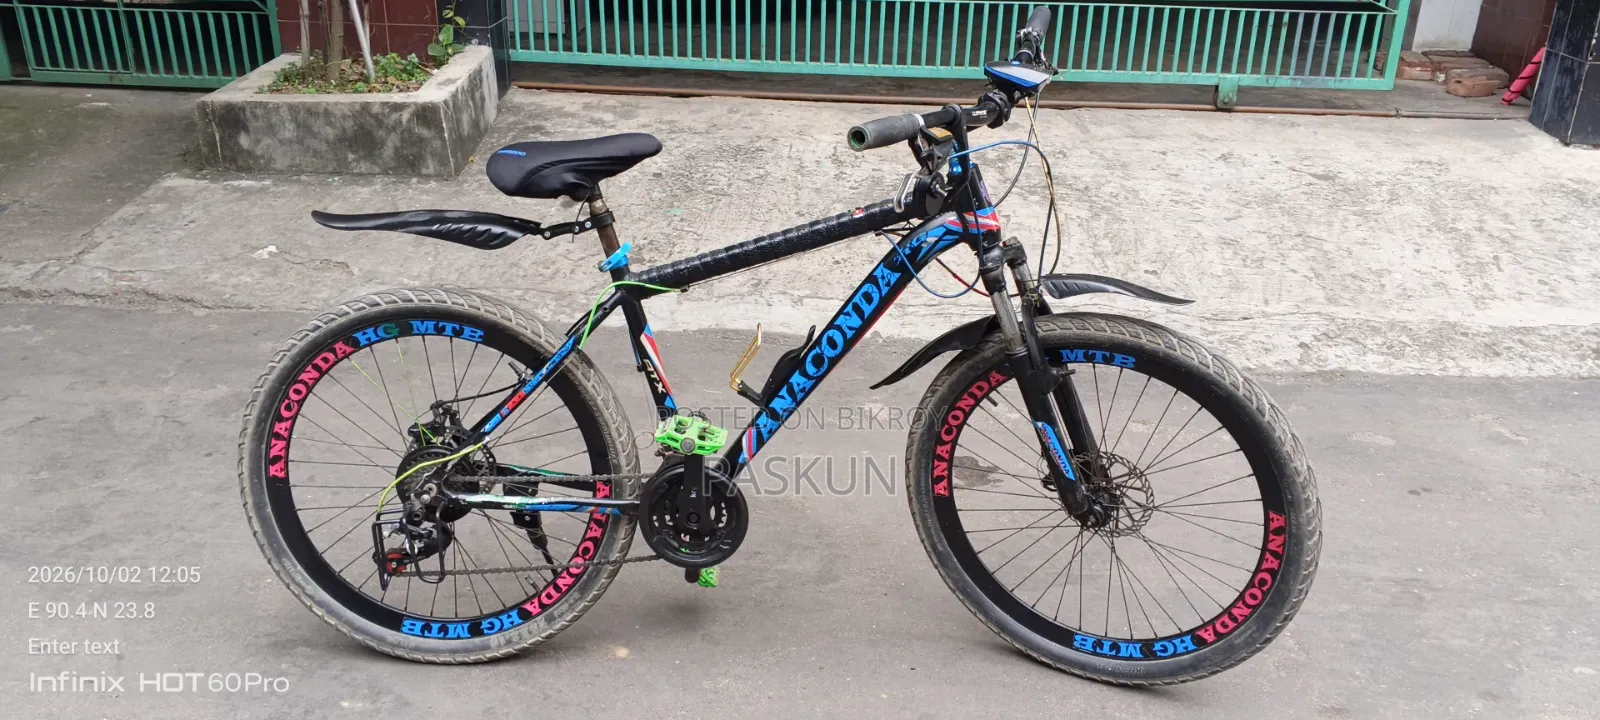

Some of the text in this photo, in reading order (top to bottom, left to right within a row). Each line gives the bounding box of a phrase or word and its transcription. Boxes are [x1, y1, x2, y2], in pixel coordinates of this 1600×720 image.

[268, 319, 484, 479] ANACONDA HG MTB
[753, 261, 902, 442] ANACONDA
[1060, 348, 1137, 369] MTB
[933, 370, 1006, 498] ANACONDA
[401, 617, 473, 640] MTB
[479, 608, 525, 637] HG
[1073, 510, 1287, 660] ANACONDA HG MTB
